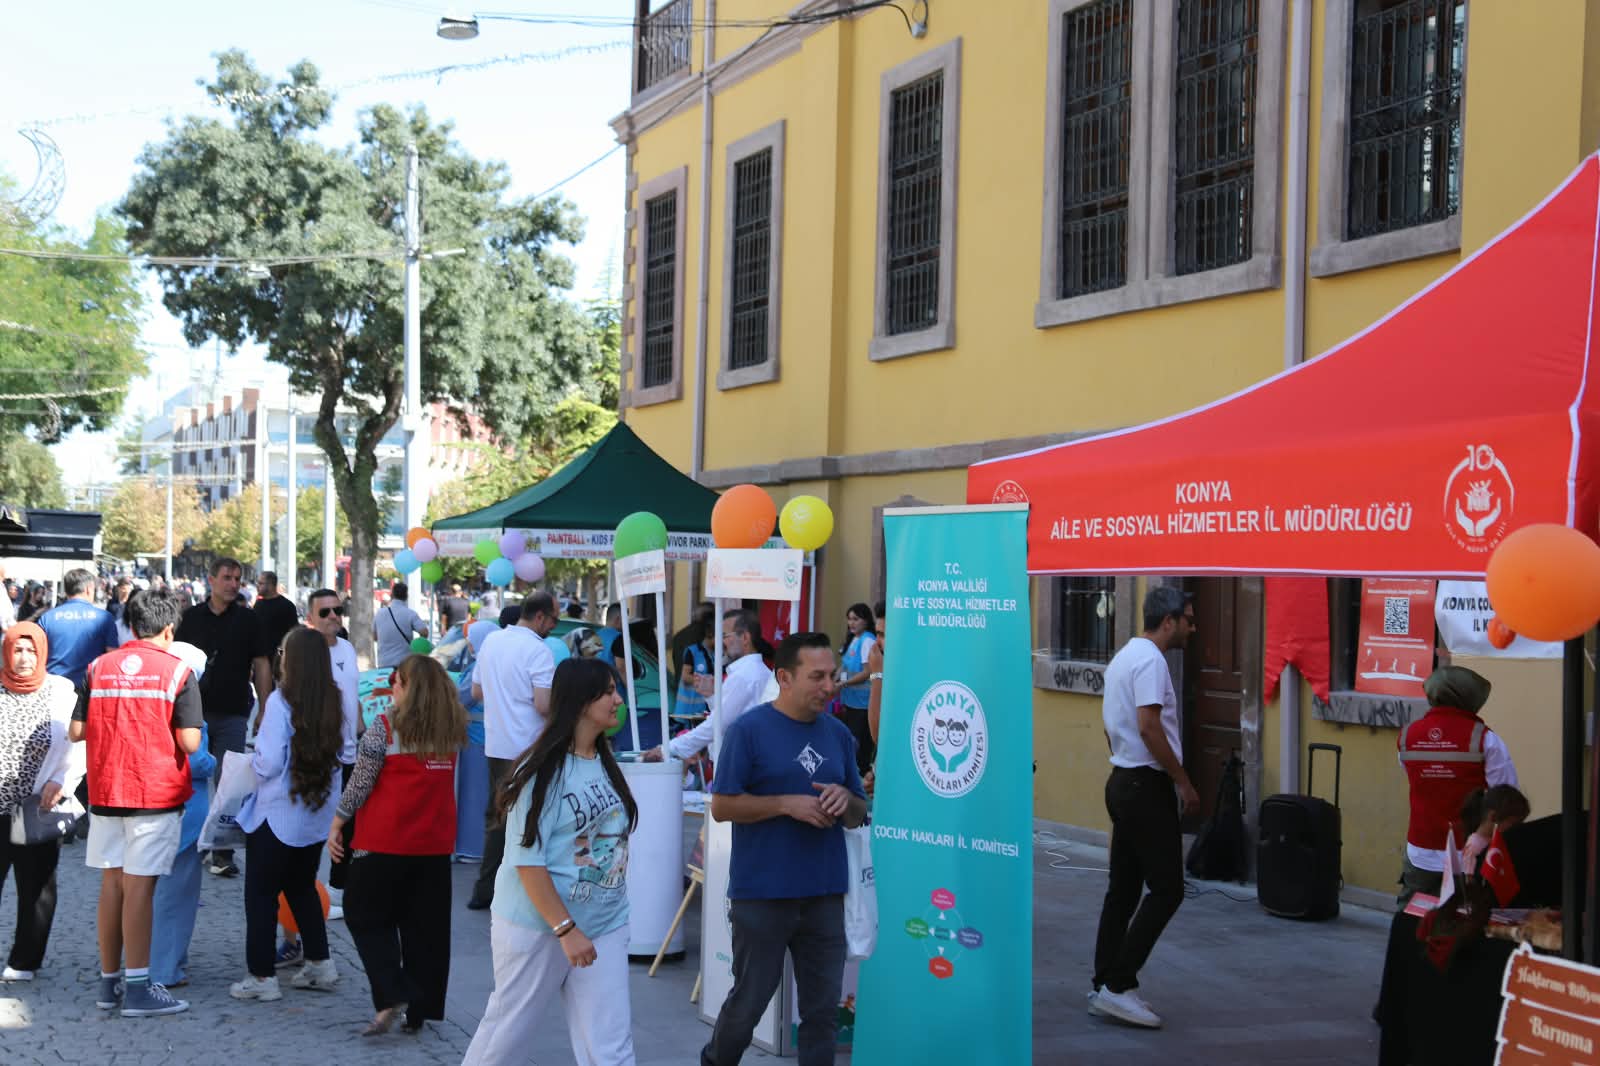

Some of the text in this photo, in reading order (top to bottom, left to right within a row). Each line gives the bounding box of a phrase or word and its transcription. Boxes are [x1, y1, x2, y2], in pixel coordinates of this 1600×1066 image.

[1176, 481, 1231, 504] KONYA
[1050, 502, 1412, 540] AİLE VE SOSYAL HİZMETLER İL MÜDÜRLÜĞÜ
[591, 534, 609, 545] KIDS
[945, 562, 962, 575] T.C.
[918, 578, 988, 593] KONYA VALİLİĞİ
[893, 595, 1017, 611] AİLE VE SOSYAL HİZMETLER
[1442, 597, 1476, 611] KONYA
[917, 612, 986, 629] İL MÜDÜRLÜĞÜ
[926, 691, 976, 720] KONYA
[917, 727, 928, 768] ÇOCUK
[926, 768, 962, 792] HAKLARI
[874, 824, 1019, 857] ÇOCUK HAKLARI İL KOMİTESİ
